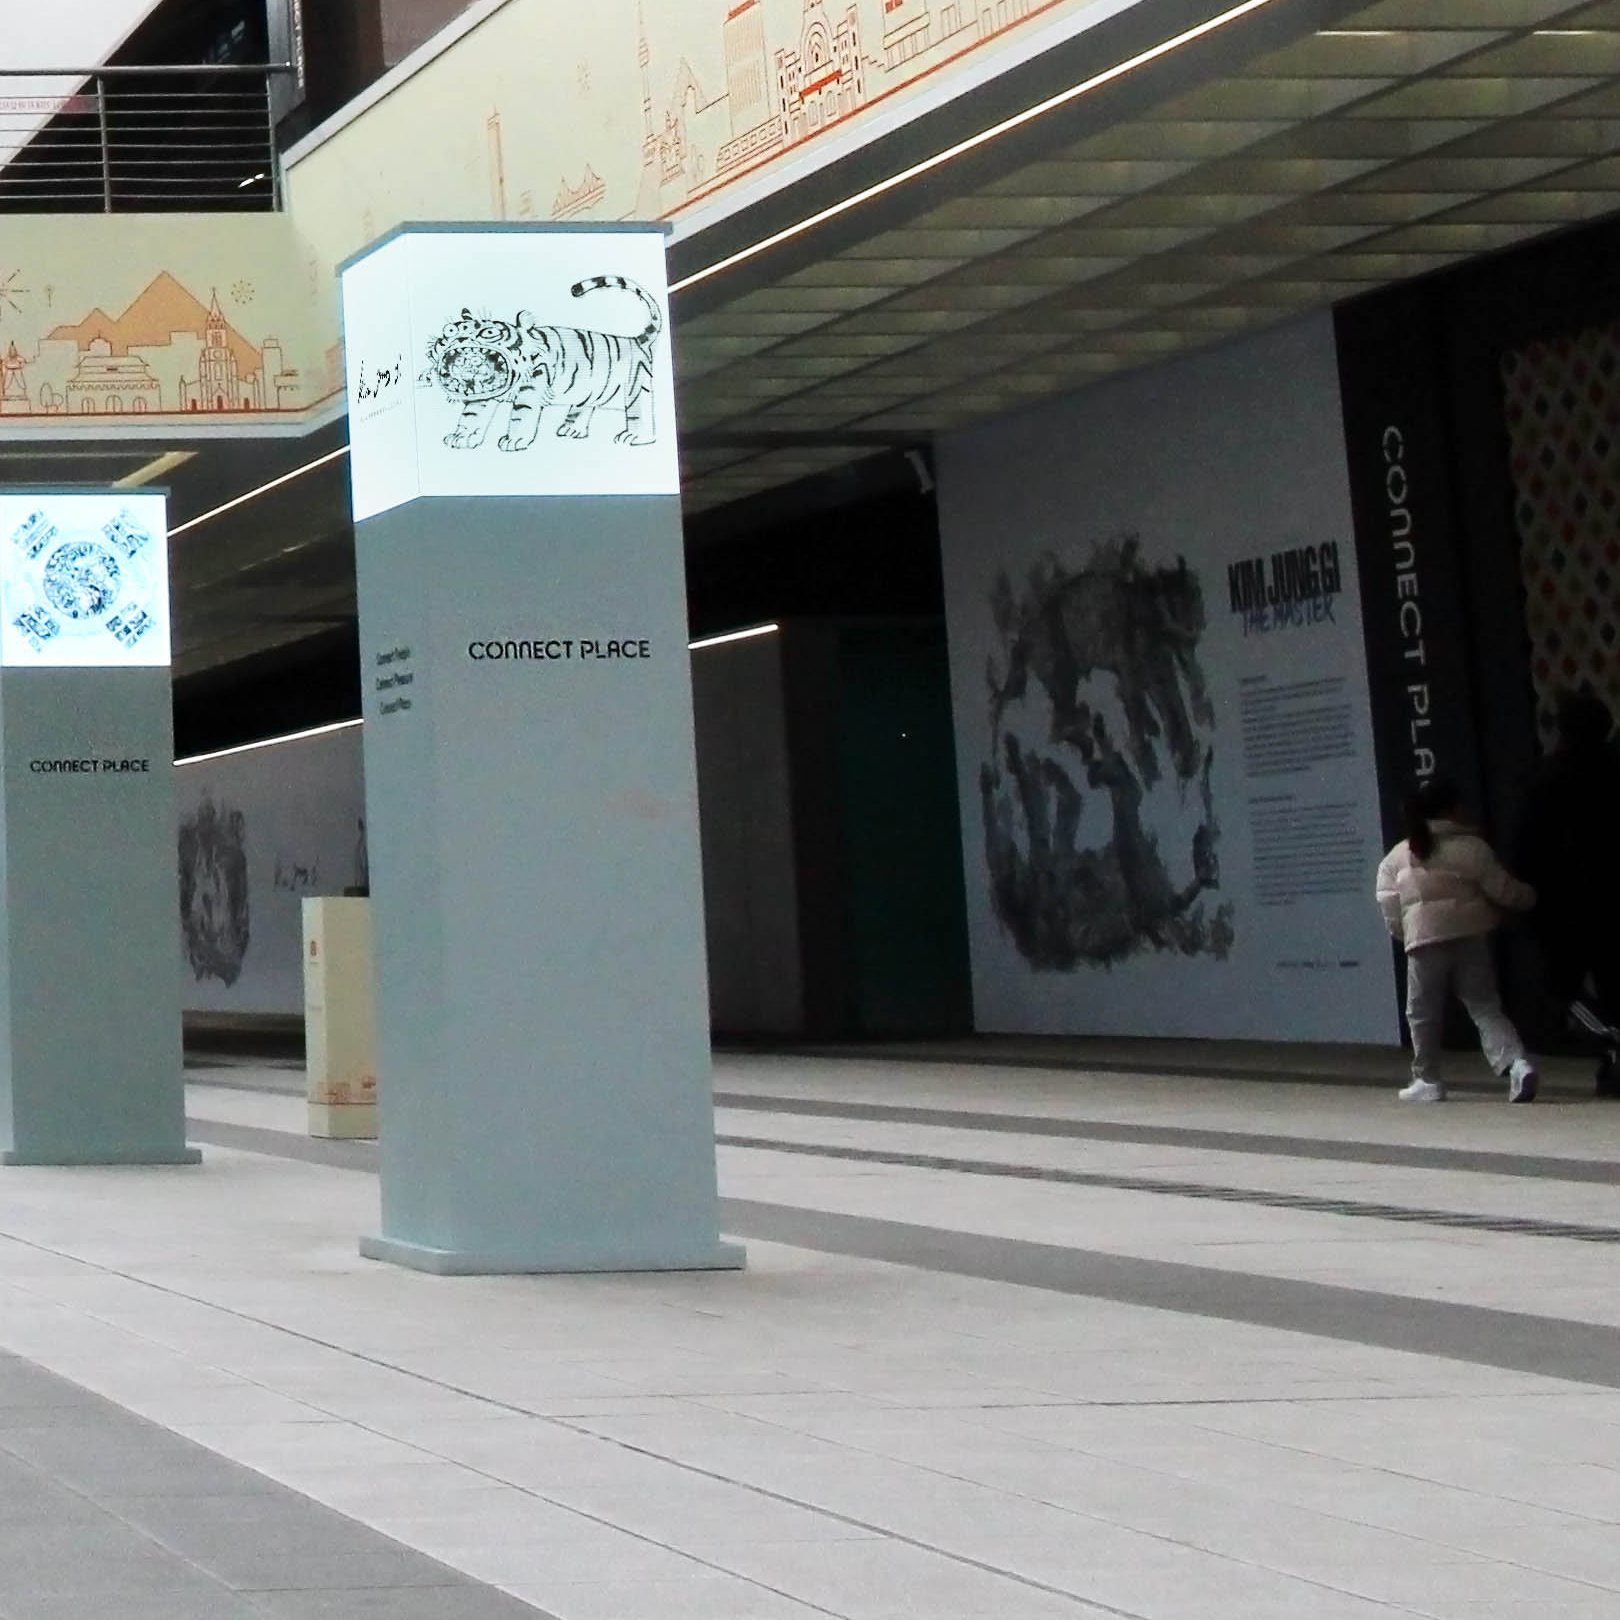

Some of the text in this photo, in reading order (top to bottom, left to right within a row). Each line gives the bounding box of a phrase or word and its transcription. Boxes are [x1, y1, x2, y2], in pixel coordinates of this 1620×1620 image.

[1228, 557, 1267, 613] KIM
[1382, 425, 1437, 788] CONNECT PLA
[468, 640, 650, 660] CONNECT PLACE
[30, 759, 150, 773] CONNECT PLACE
